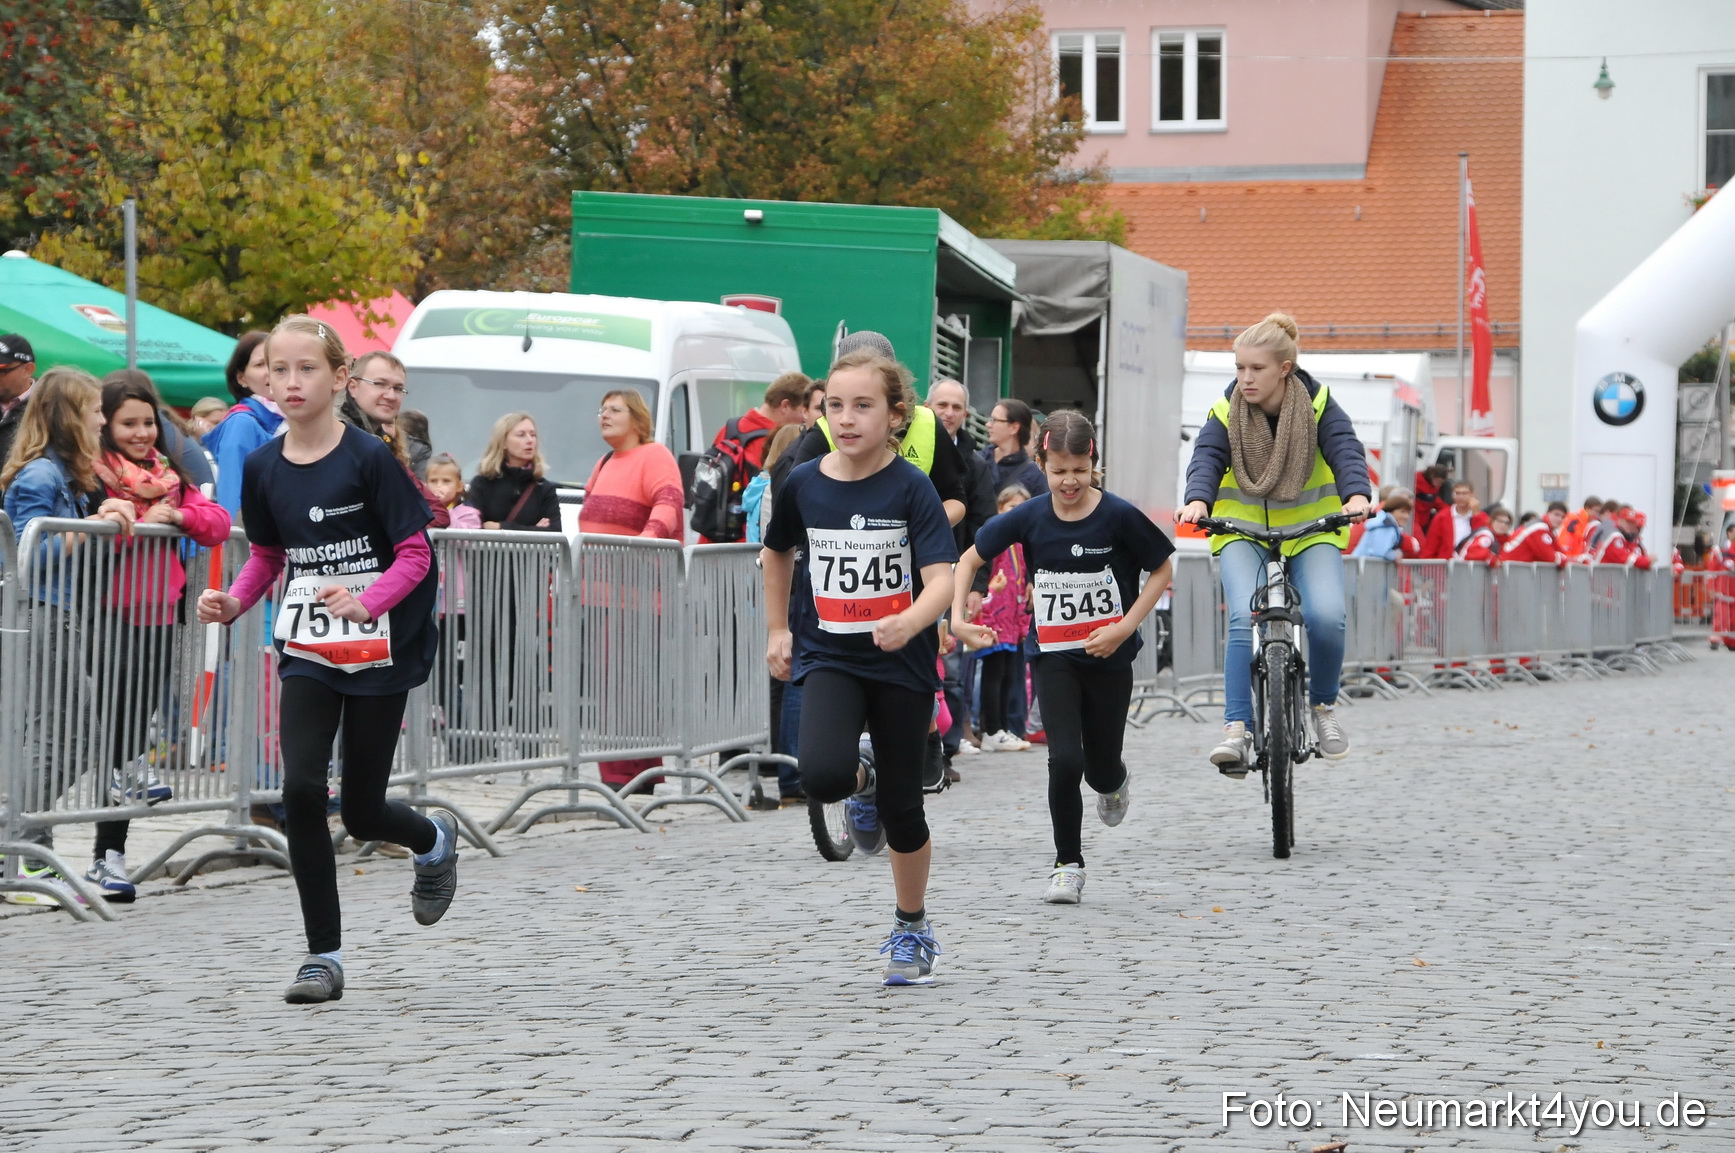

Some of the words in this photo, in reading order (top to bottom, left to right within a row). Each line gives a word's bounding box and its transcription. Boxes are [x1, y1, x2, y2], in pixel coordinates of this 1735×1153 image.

[526, 313, 600, 325] Europcar
[513, 323, 553, 332] moving
[556, 325, 579, 333] your
[580, 328, 605, 336] way
[810, 539, 841, 550] PARTL
[845, 540, 895, 550] Neumarkt
[818, 553, 903, 593] 7545
[1062, 580, 1103, 589] Neumarkt
[287, 586, 309, 597] ARTL
[843, 602, 872, 617] Mia
[1041, 589, 1114, 621] 7543
